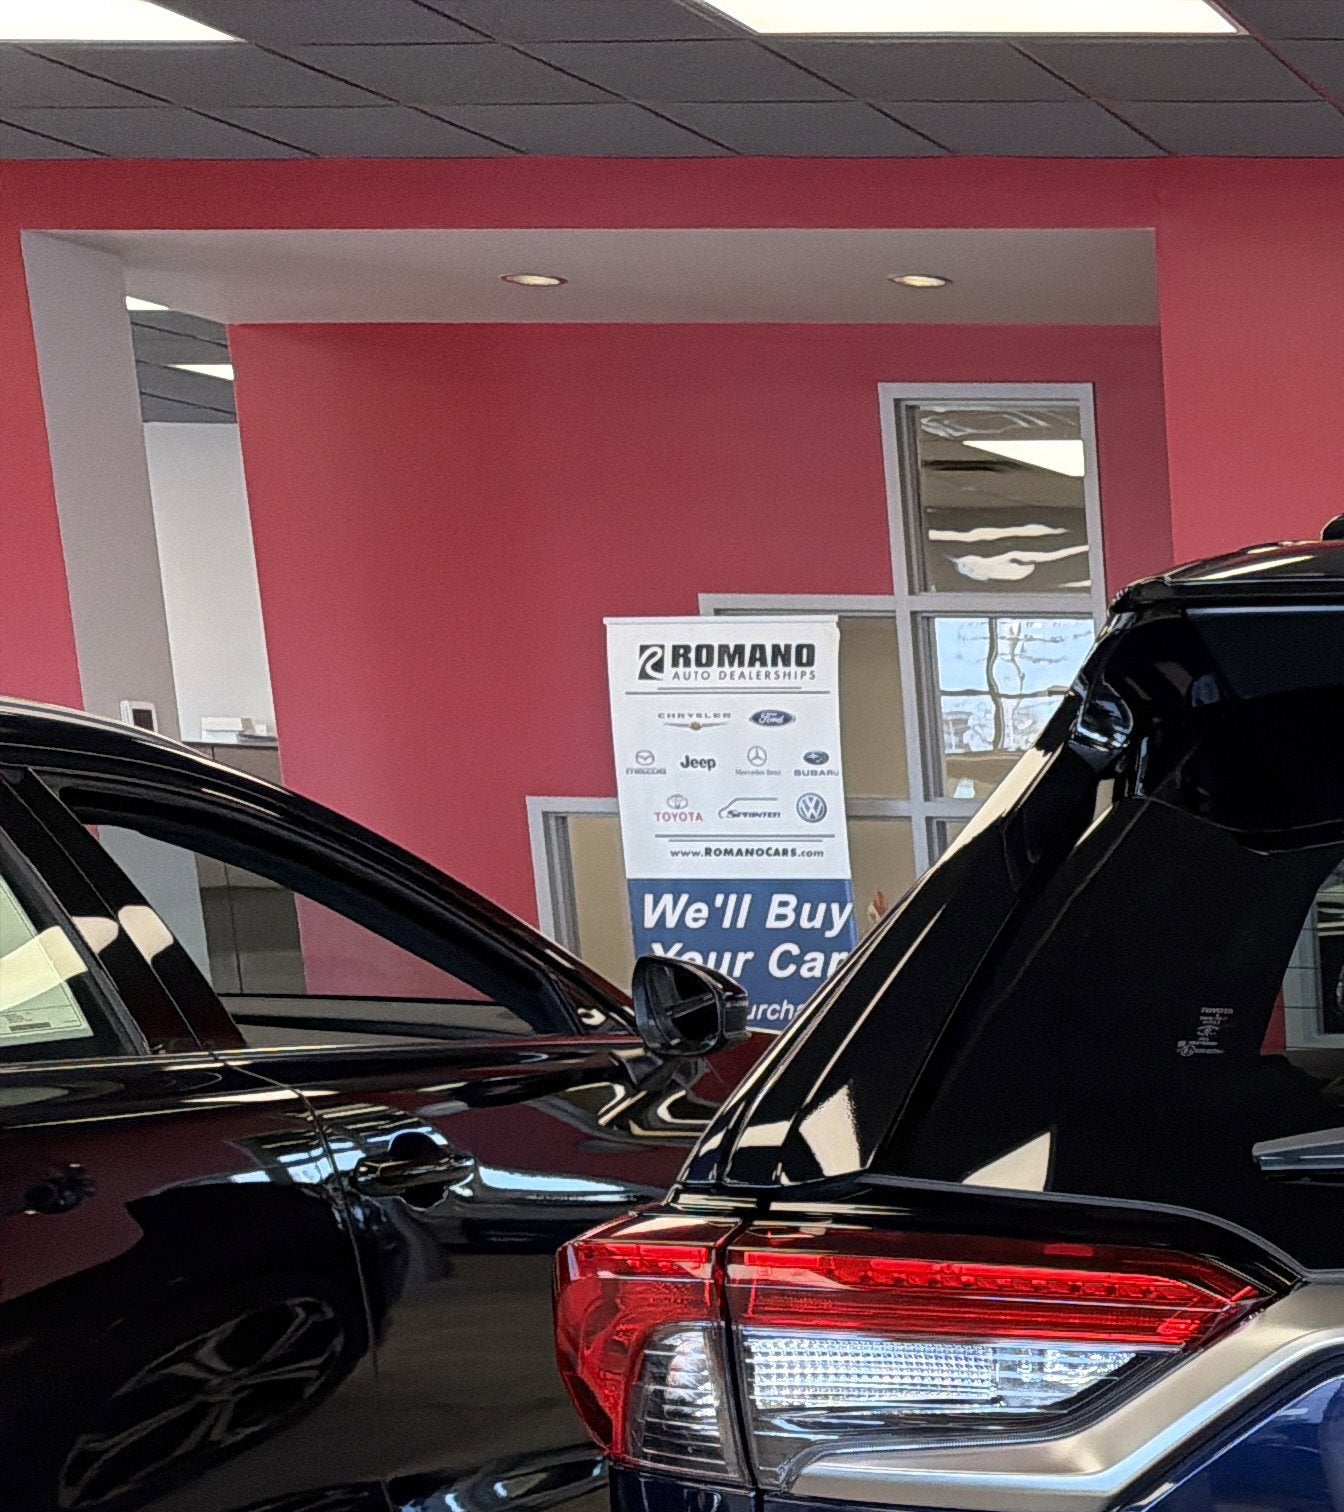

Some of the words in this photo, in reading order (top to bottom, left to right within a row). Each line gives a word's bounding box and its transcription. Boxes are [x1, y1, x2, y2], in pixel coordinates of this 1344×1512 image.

[671, 643, 816, 668] ROMANO
[672, 670, 711, 681] AUTO
[718, 670, 816, 681] DEALERSHIPS
[680, 754, 717, 772] Jeep
[654, 811, 704, 822] TOYOTA
[643, 893, 752, 928] We'll
[765, 893, 853, 938] Buy
[768, 942, 850, 979] Car
